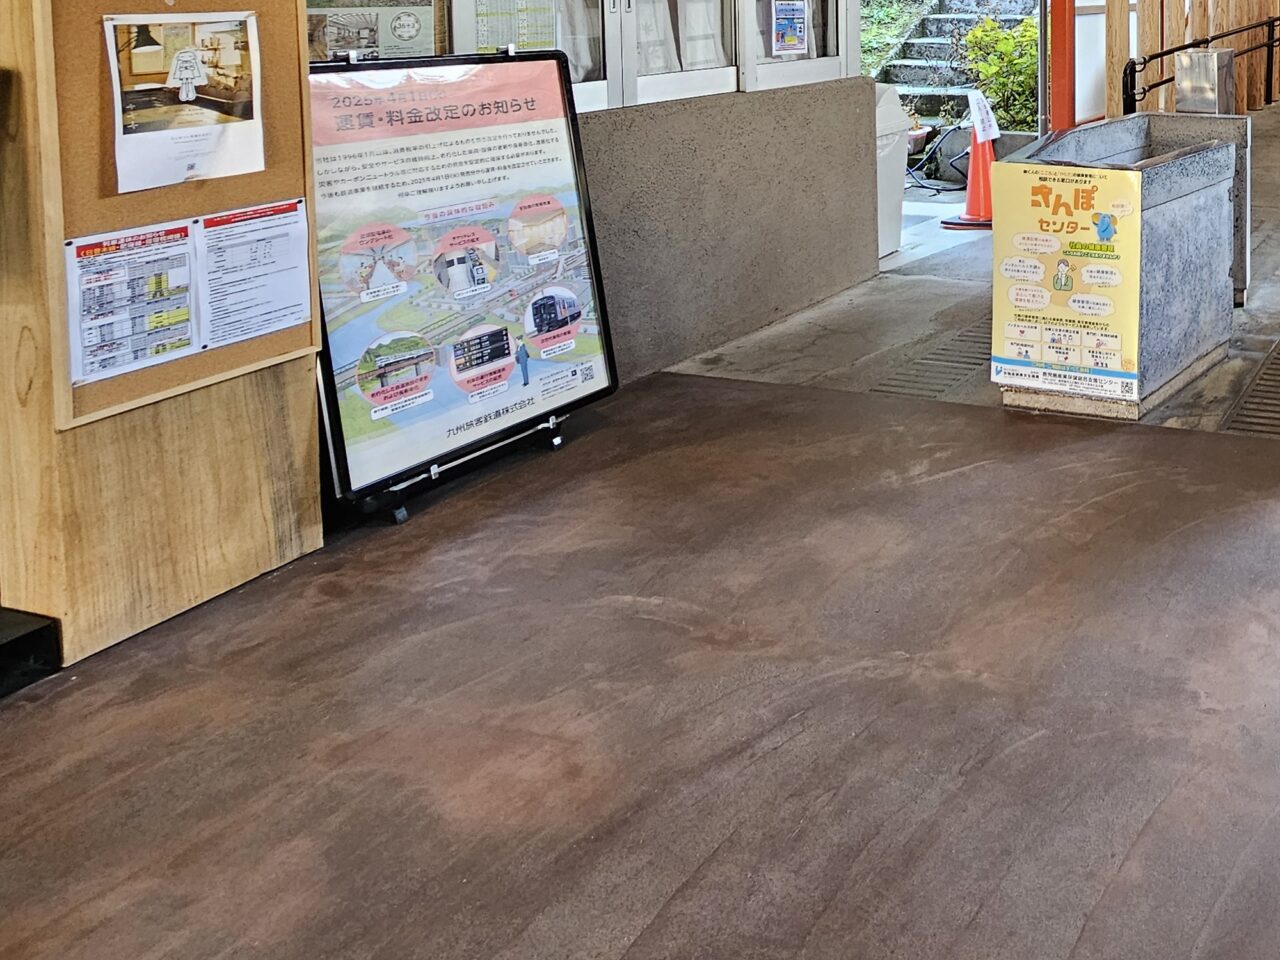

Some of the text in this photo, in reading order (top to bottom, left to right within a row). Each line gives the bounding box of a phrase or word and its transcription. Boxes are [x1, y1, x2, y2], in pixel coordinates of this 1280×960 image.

[335, 97, 537, 132] 運賃・料金改定のお知らせ
[1031, 184, 1099, 217] さんぽ
[1038, 218, 1091, 235] センター
[446, 396, 536, 439] 九州旅客鉄道株式会社
